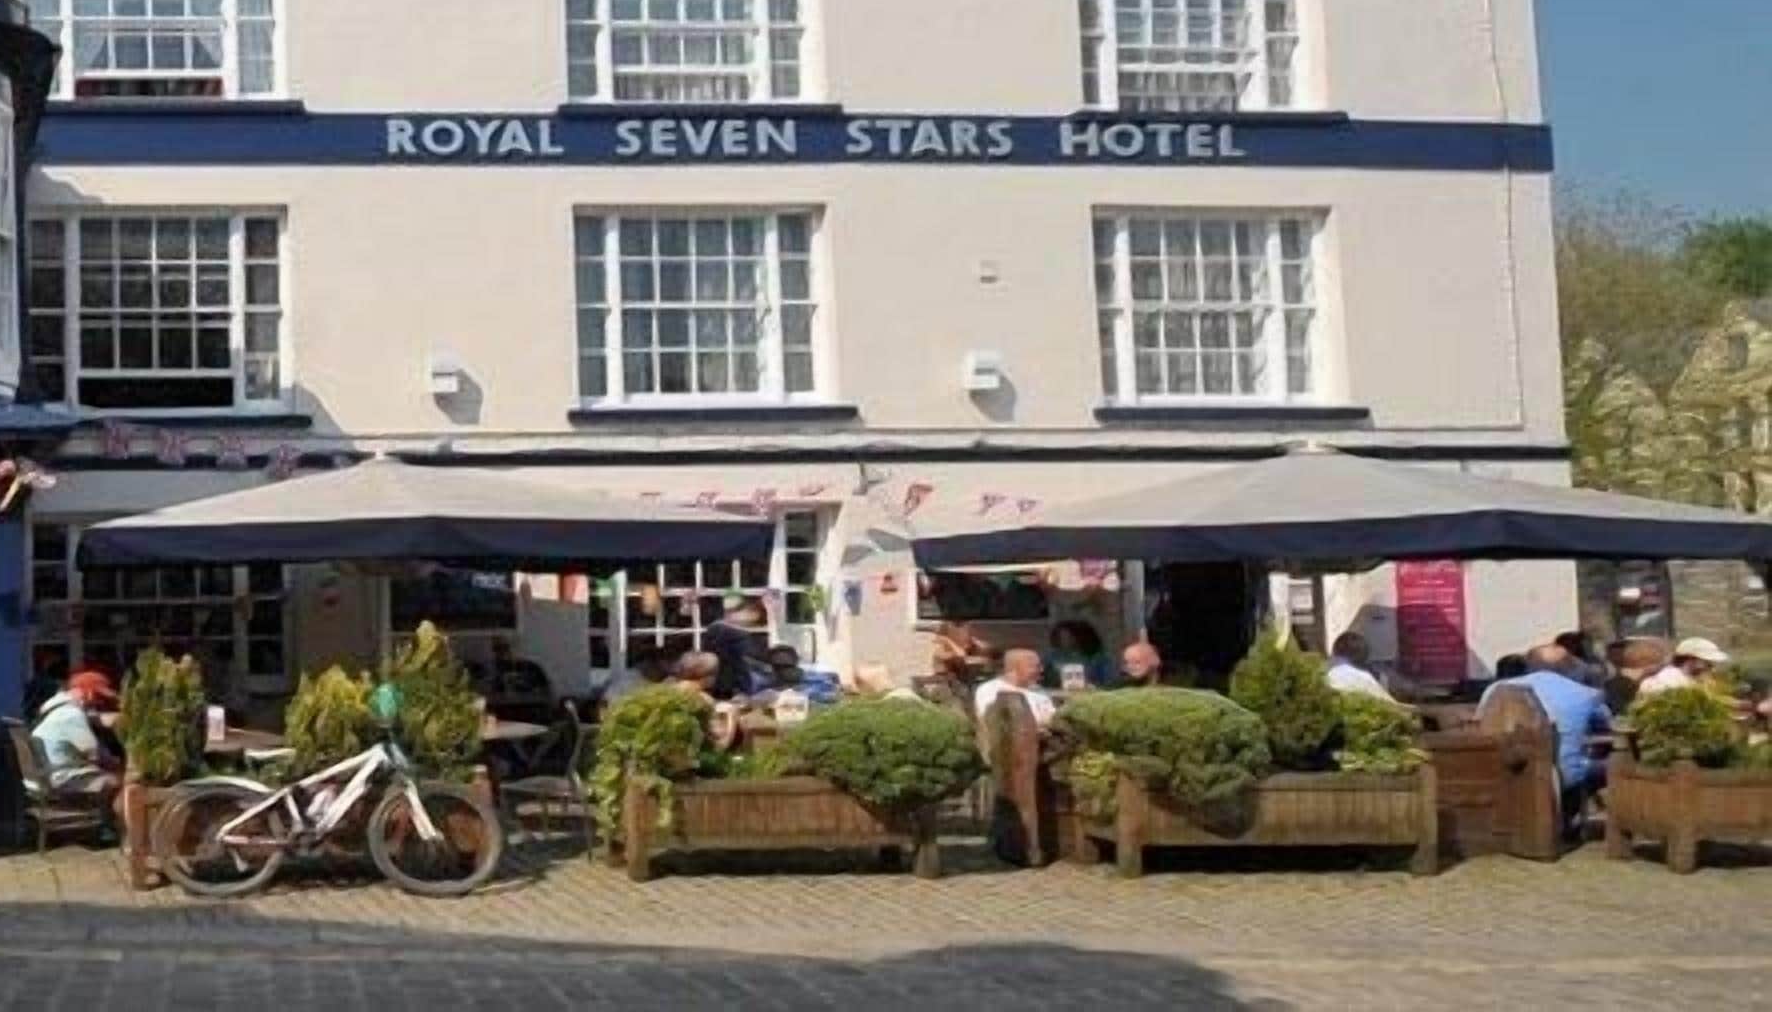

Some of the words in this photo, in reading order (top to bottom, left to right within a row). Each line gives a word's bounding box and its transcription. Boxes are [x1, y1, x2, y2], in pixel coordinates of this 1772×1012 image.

[386, 119, 565, 156] ROYAL
[615, 119, 797, 155] SEVEN
[845, 119, 1013, 156] STARS
[1060, 122, 1248, 157] HOTEL
